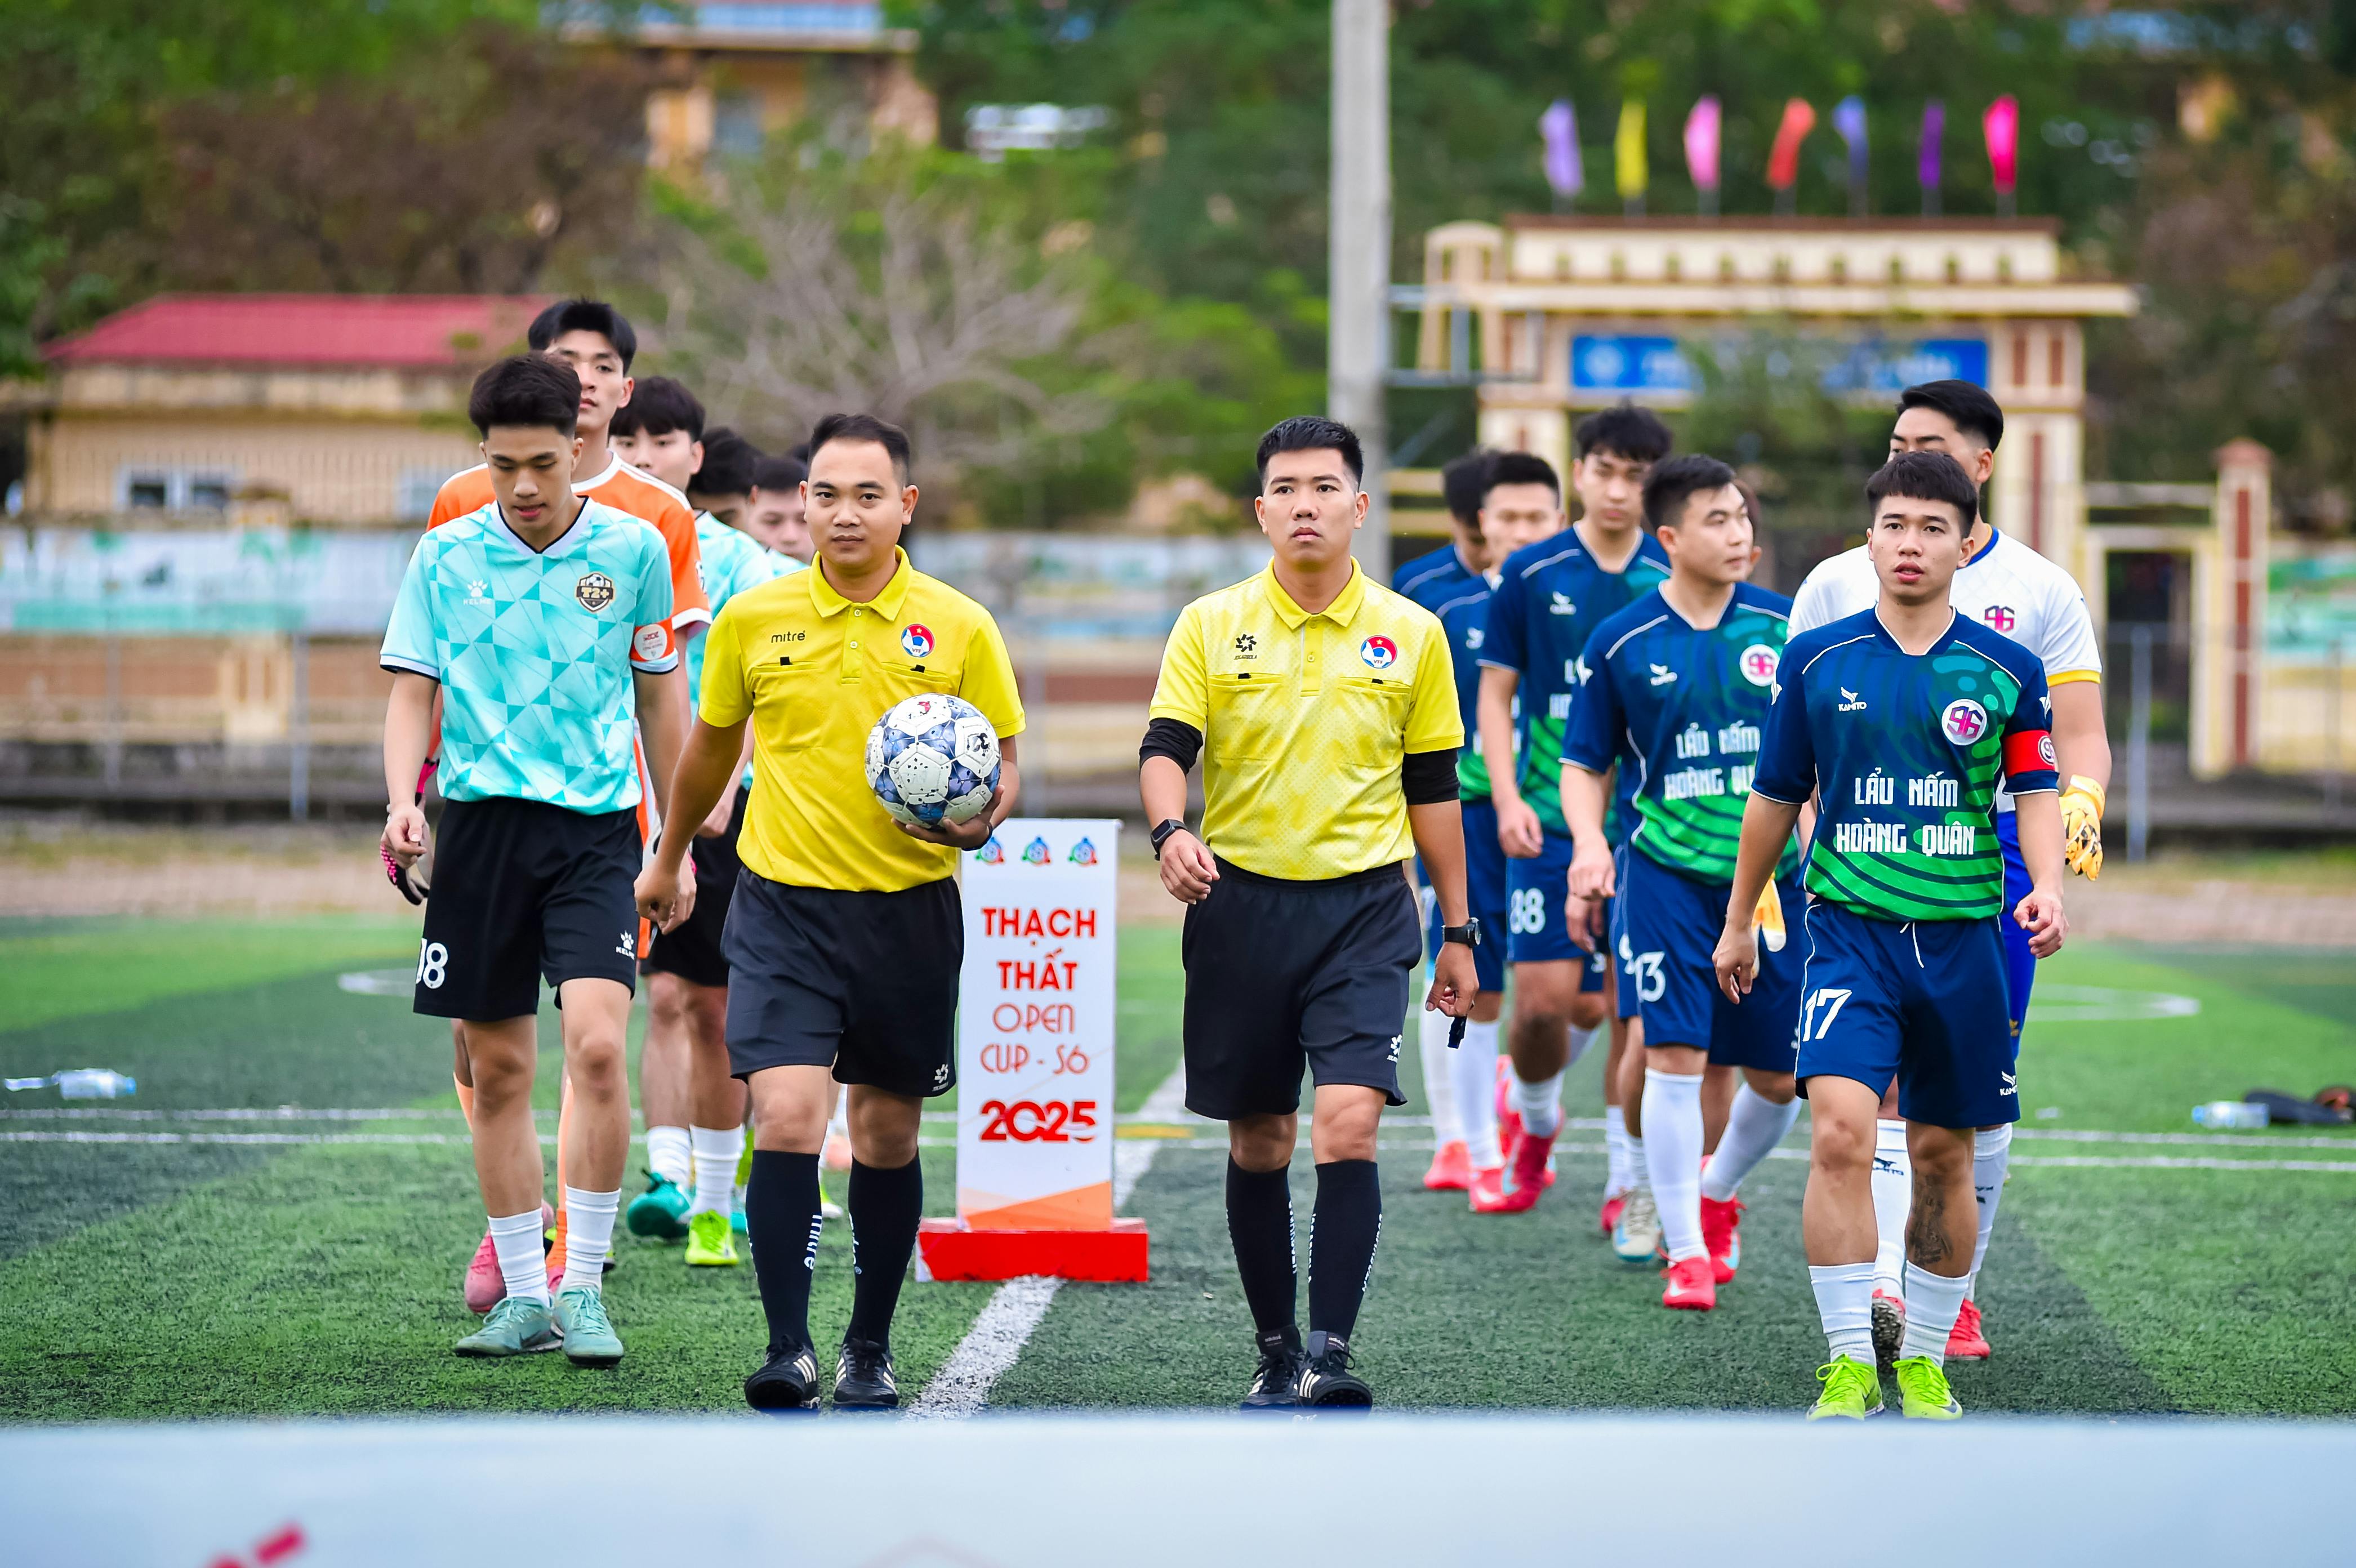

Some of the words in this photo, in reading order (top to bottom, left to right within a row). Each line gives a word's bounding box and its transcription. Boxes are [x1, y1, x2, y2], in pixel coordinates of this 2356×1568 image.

[771, 630, 806, 643] mitre
[1838, 701, 1867, 712] KAMITO
[1855, 767, 1894, 805] LẨU
[1908, 771, 1958, 807] NẤM
[1836, 817, 1907, 853] HOÀNG
[1922, 821, 1975, 857] QUÂN
[982, 908, 1095, 946] THẠCH
[997, 948, 1078, 990] THẤT
[1802, 988, 1852, 1042] 17
[981, 1044, 1029, 1073] CUP
[981, 1101, 1097, 1142] 2025
